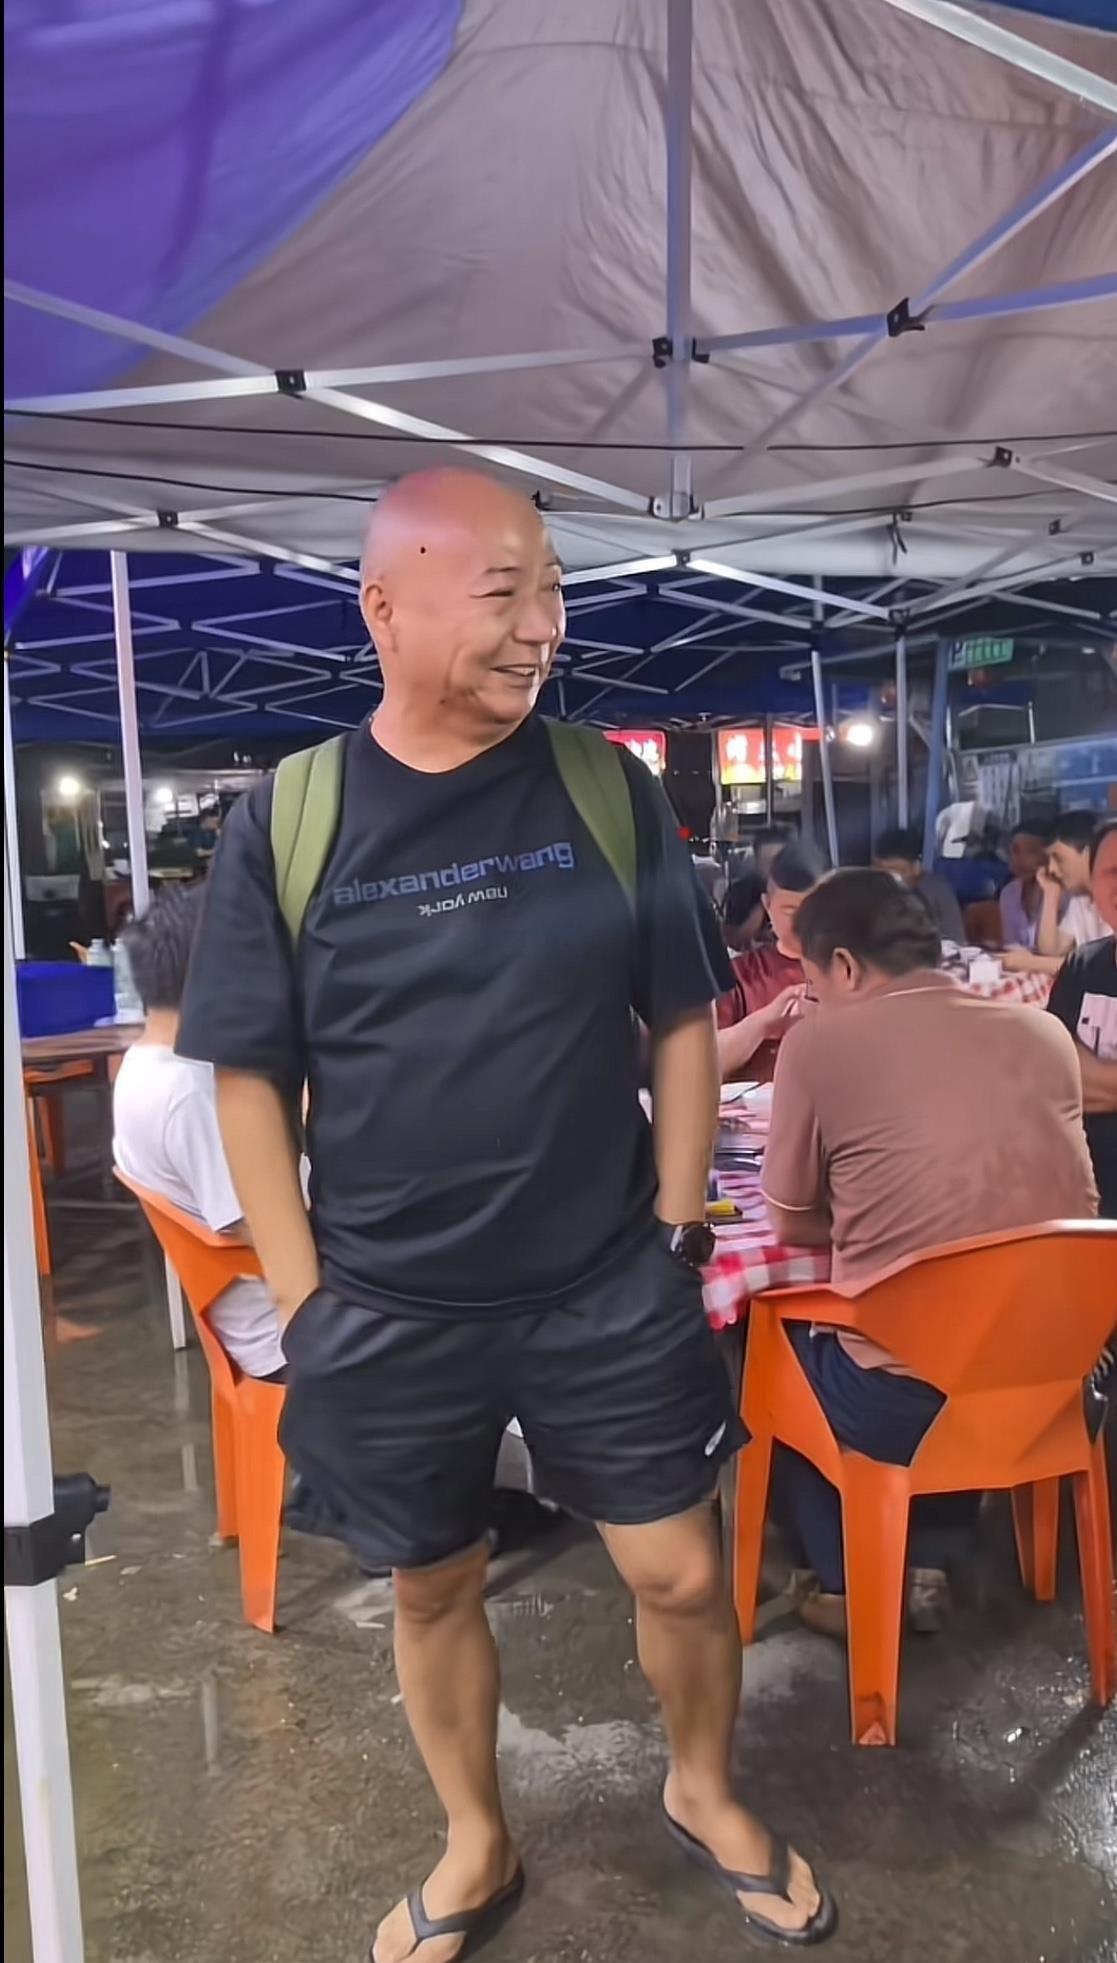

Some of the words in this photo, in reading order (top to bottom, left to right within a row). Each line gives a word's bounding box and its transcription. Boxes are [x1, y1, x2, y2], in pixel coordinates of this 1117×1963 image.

[333, 842, 574, 905] alexanderwang
[417, 893, 464, 917] york
[468, 886, 508, 904] new
